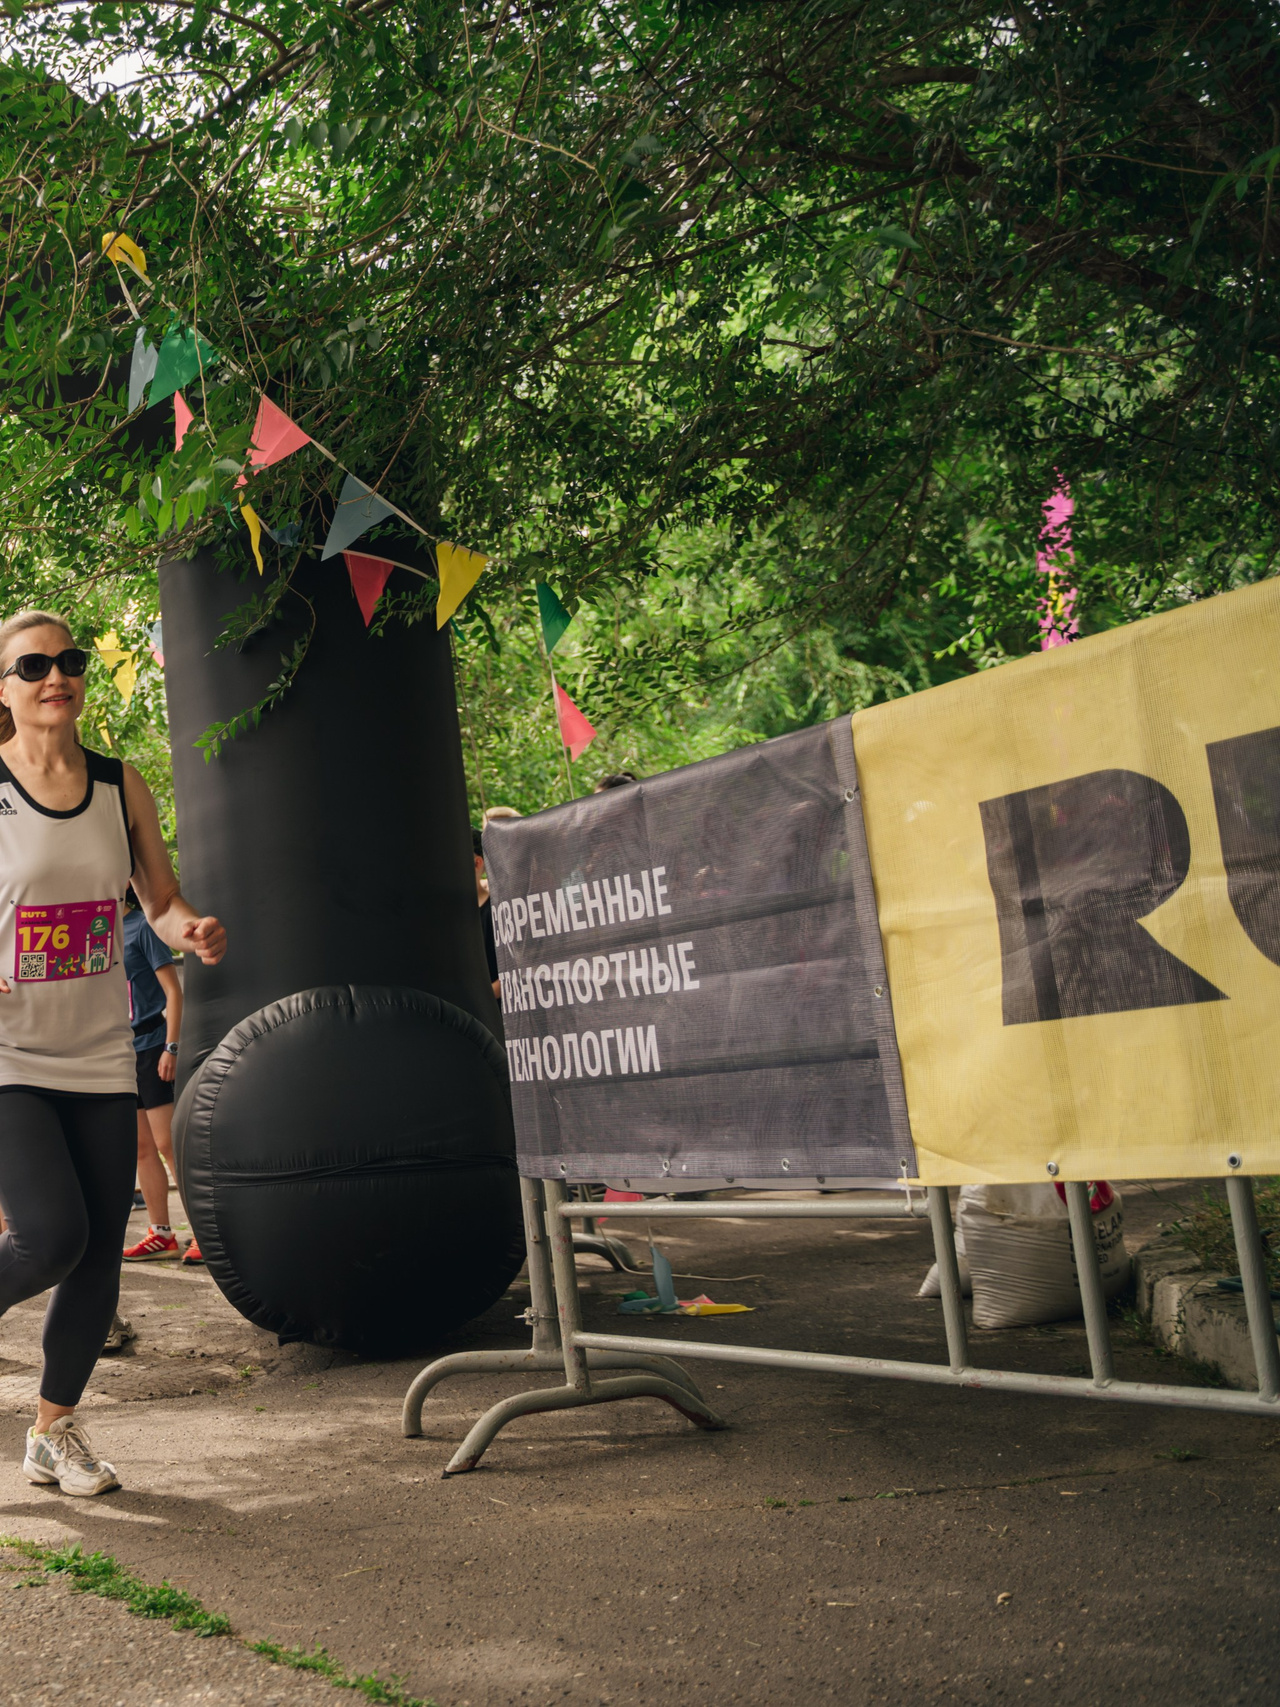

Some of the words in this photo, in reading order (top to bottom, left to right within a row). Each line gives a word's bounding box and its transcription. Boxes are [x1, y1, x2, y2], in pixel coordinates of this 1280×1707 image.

[20, 911, 48, 919] RUTS
[94, 919, 104, 929] 2
[18, 924, 70, 952] 176
[498, 941, 700, 1014] ТРАНСПОРТНЫЕ
[505, 1024, 662, 1082] ТЕХНОЛОГИИ
